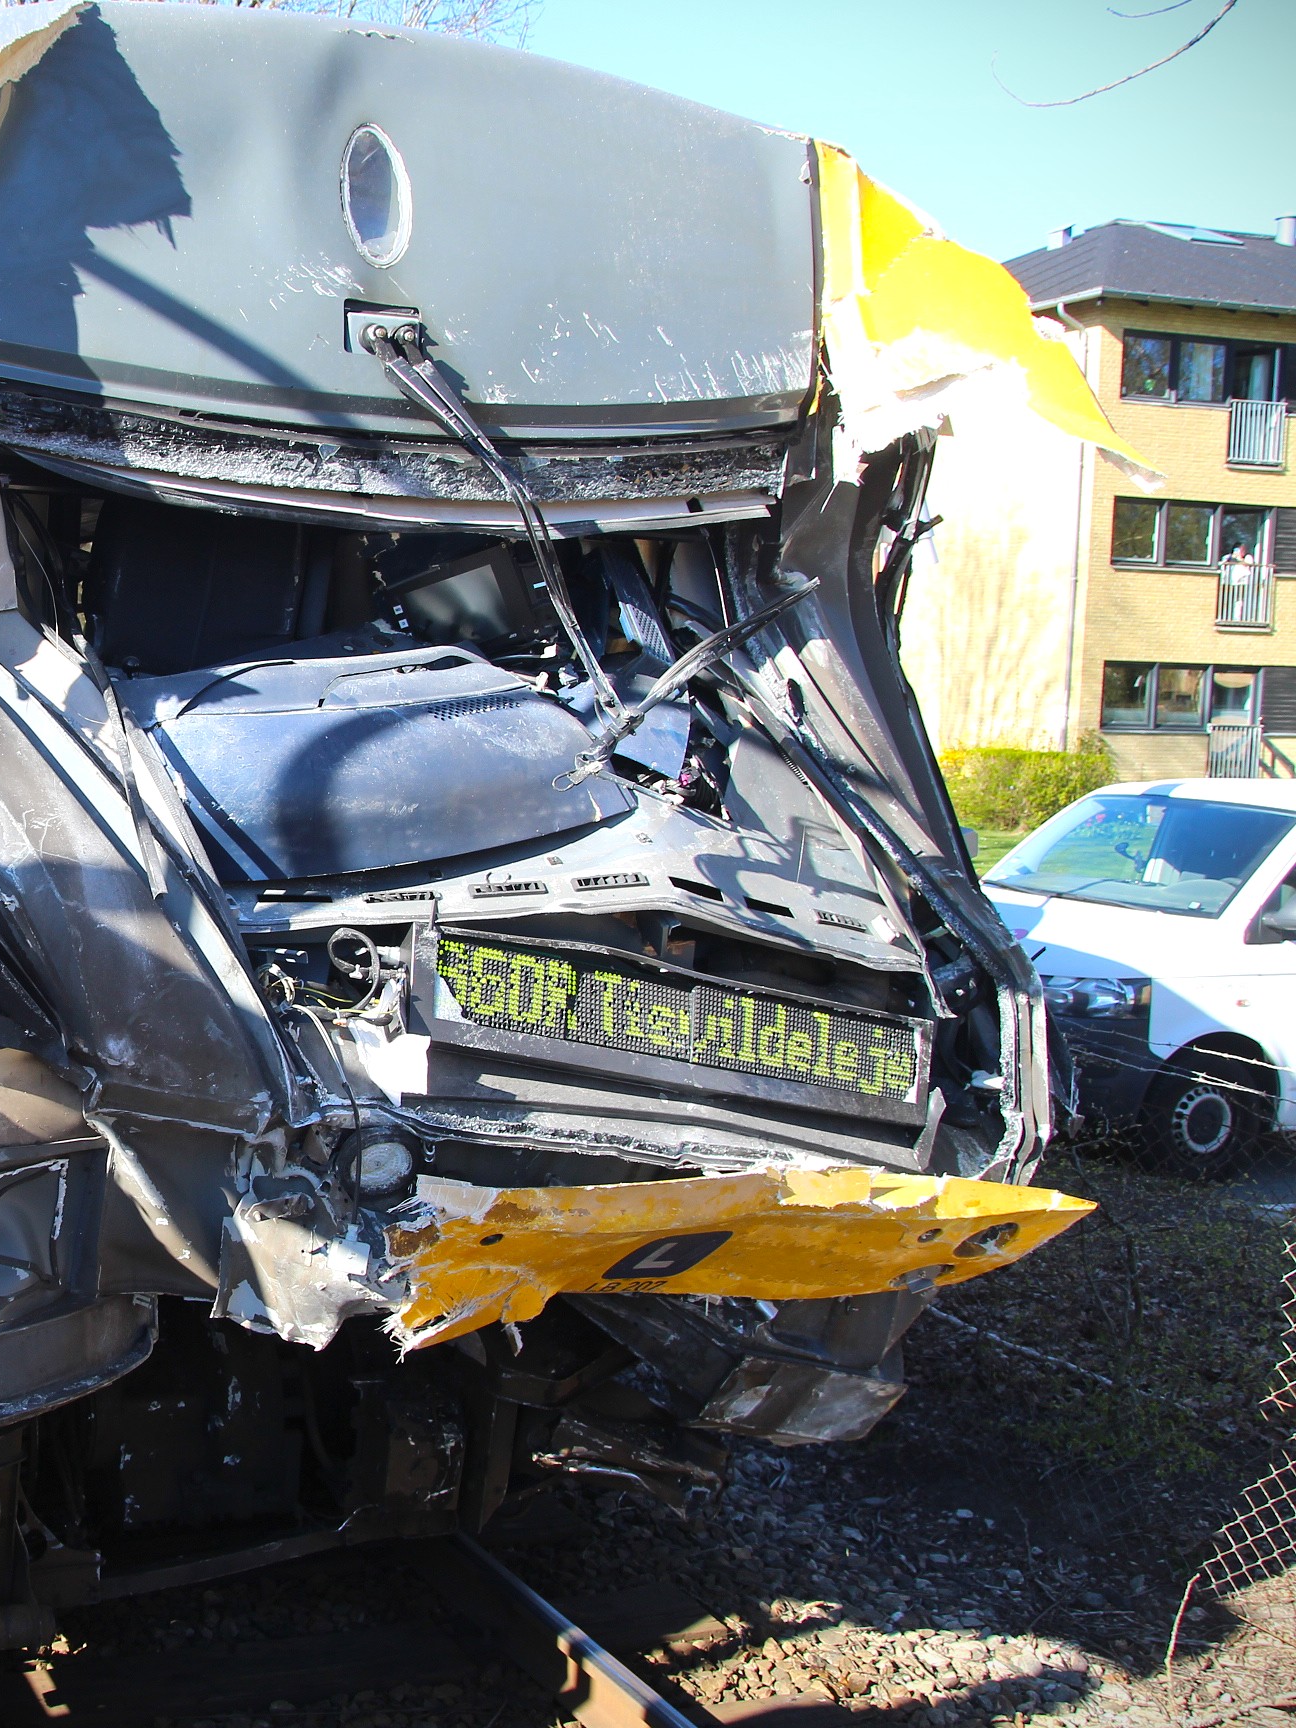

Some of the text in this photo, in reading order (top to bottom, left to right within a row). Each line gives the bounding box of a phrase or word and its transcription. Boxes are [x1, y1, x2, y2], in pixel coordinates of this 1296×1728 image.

[595, 970, 912, 1096] Tisvildeleje
[633, 1243, 678, 1270] L
[622, 1281, 668, 1292] 207
